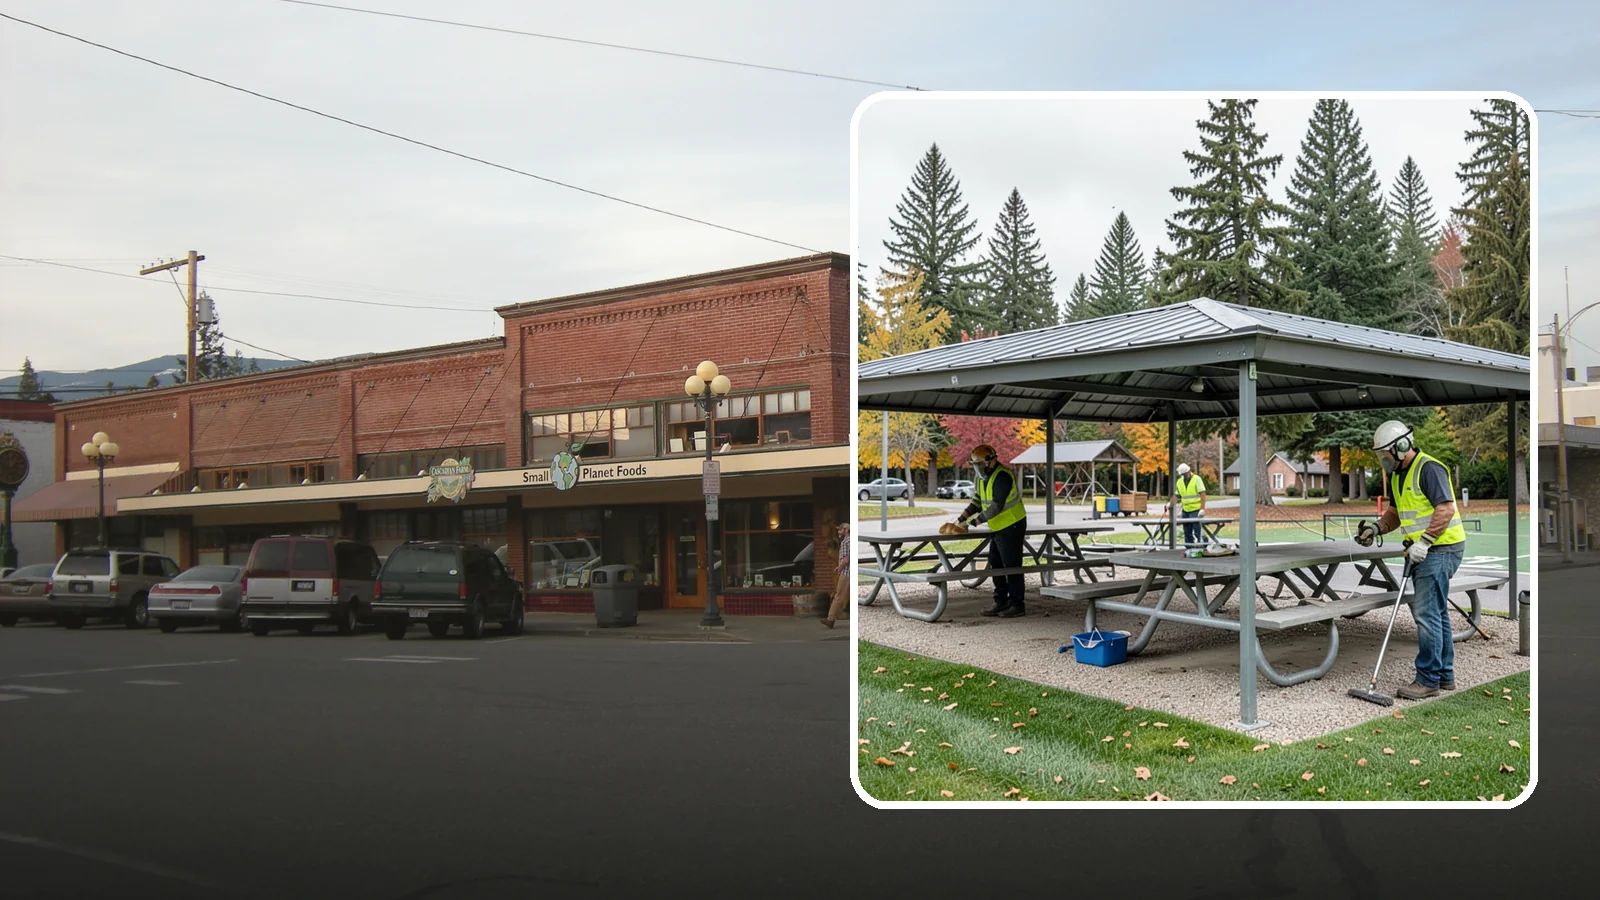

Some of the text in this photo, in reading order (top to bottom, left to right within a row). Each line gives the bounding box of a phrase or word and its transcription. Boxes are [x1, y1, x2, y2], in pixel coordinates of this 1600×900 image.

[523, 464, 647, 483] Small Planet Foods
